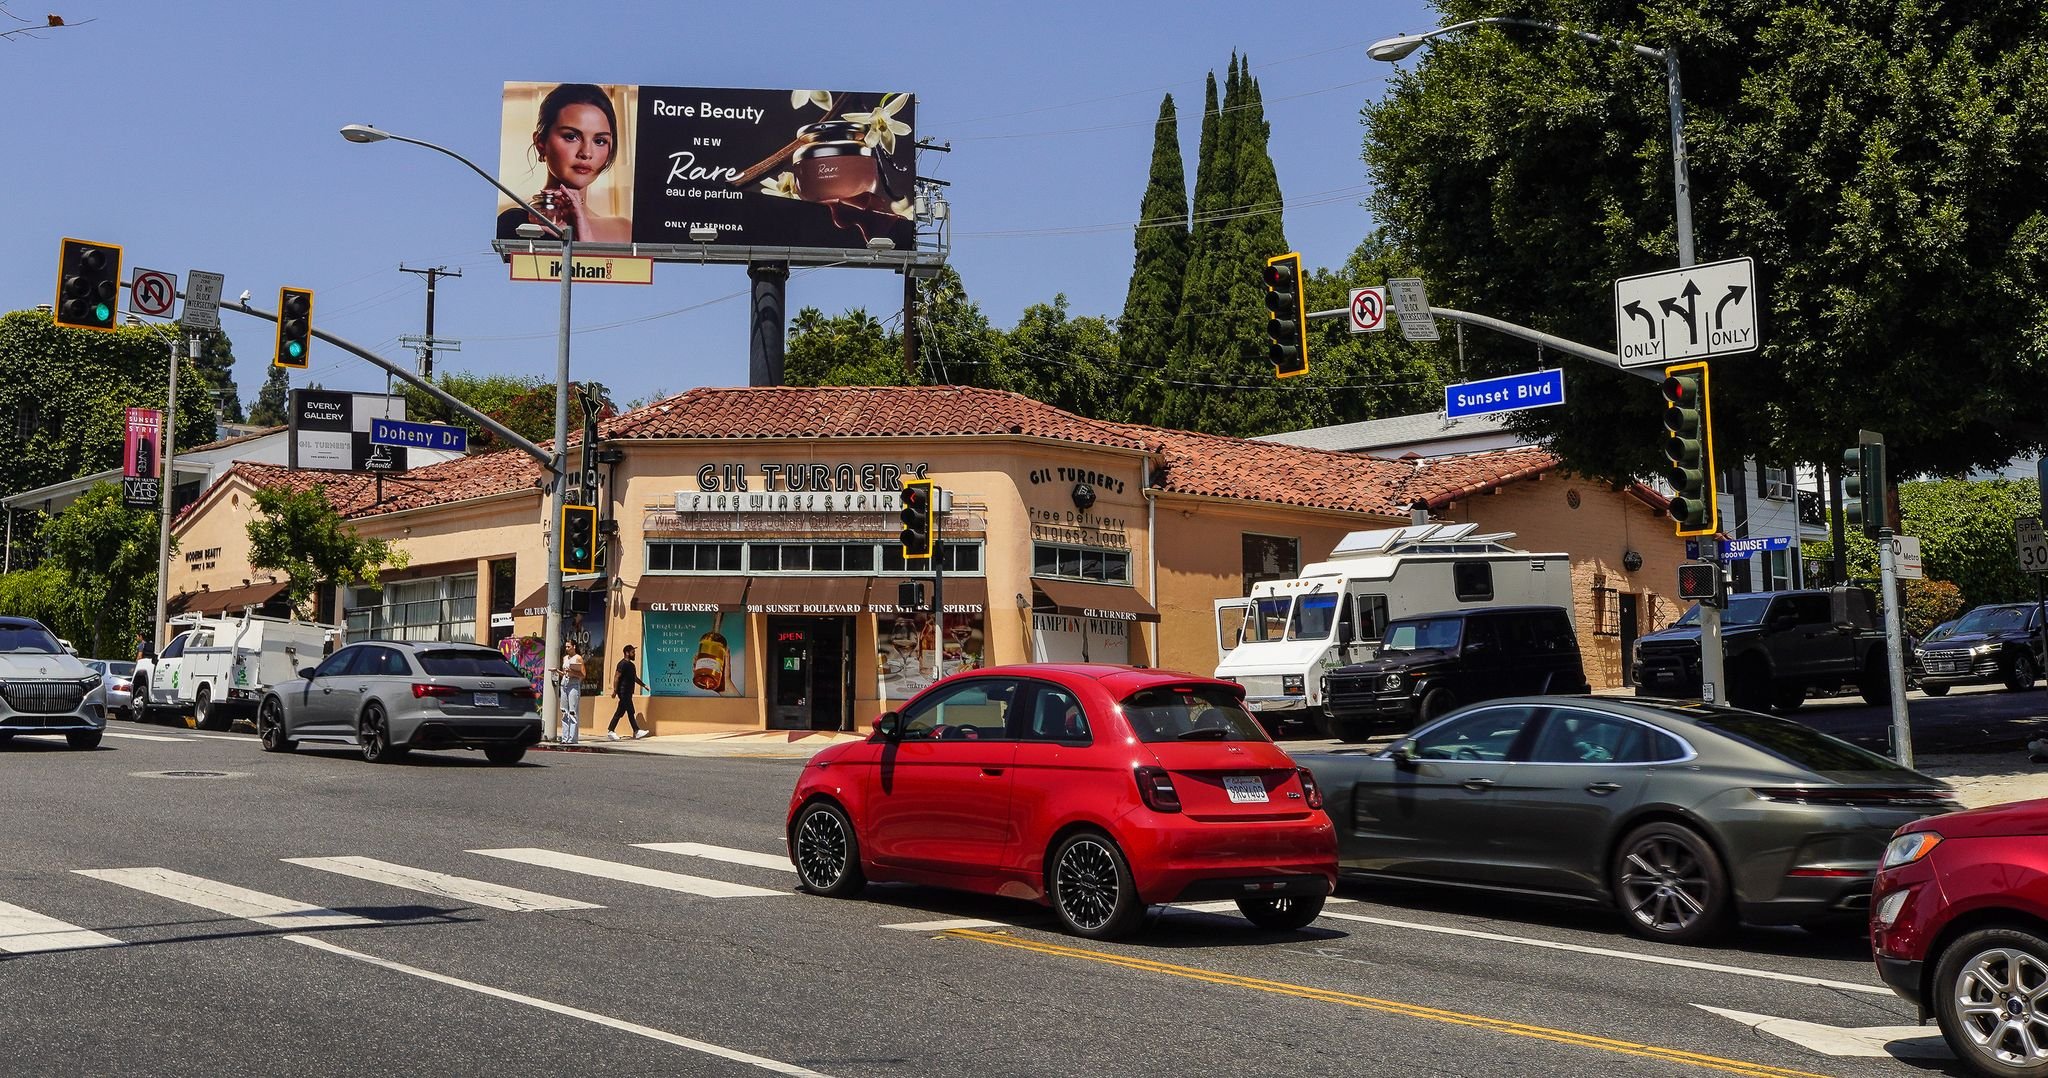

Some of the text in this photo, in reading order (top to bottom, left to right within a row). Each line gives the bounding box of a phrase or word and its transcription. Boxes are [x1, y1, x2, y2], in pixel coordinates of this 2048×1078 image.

[653, 99, 765, 125] Rare Beauty
[693, 137, 722, 147] NEW
[666, 151, 745, 185] Rare
[665, 187, 743, 200] eau de parfum
[664, 220, 743, 232] ONLY AT SEPHORA
[550, 261, 606, 280] iKhan
[195, 284, 214, 294] DO NOT
[196, 292, 210, 300] BLOCK
[1400, 293, 1418, 302] DO NOT
[187, 300, 217, 309] INTERSECTION
[1404, 303, 1419, 312] BLOCK
[1400, 312, 1430, 321] INTERSECTION
[1712, 328, 1751, 346] ONLY
[1624, 341, 1661, 358] ONLY
[1457, 381, 1551, 407] Sunset Blvd
[307, 402, 341, 411] EVERLY
[128, 416, 159, 424] SUNSET
[304, 412, 344, 421] GALLERY
[128, 425, 159, 434] STRIP
[379, 425, 459, 446] Doheny Dr
[299, 440, 350, 450] GIL TURNER'S
[697, 463, 929, 493] GIL TURNER'S
[1030, 467, 1125, 495] GIL TURNER'S
[124, 481, 158, 498] NARS
[692, 494, 904, 512] FINE WINES & SPIR
[654, 515, 680, 528] Wine
[1029, 506, 1125, 531] Free Delivery
[1030, 524, 1126, 547] (310)652-1000
[1729, 537, 1788, 552] SUNSET BLVD
[1903, 553, 1919, 561] Metro
[2022, 545, 2048, 566] 30
[524, 606, 551, 616] GIL TURN
[650, 602, 719, 612] GIL TURNER'S
[747, 604, 861, 613] 9101 SUNSET BOULEVARD
[868, 604, 893, 613] FINE
[943, 604, 982, 613] SPIRITS
[1083, 607, 1137, 621] GIL TURNER'S
[1090, 618, 1124, 636] WATER
[785, 660, 793, 668] A
[906, 681, 931, 689] CHÂTEA
